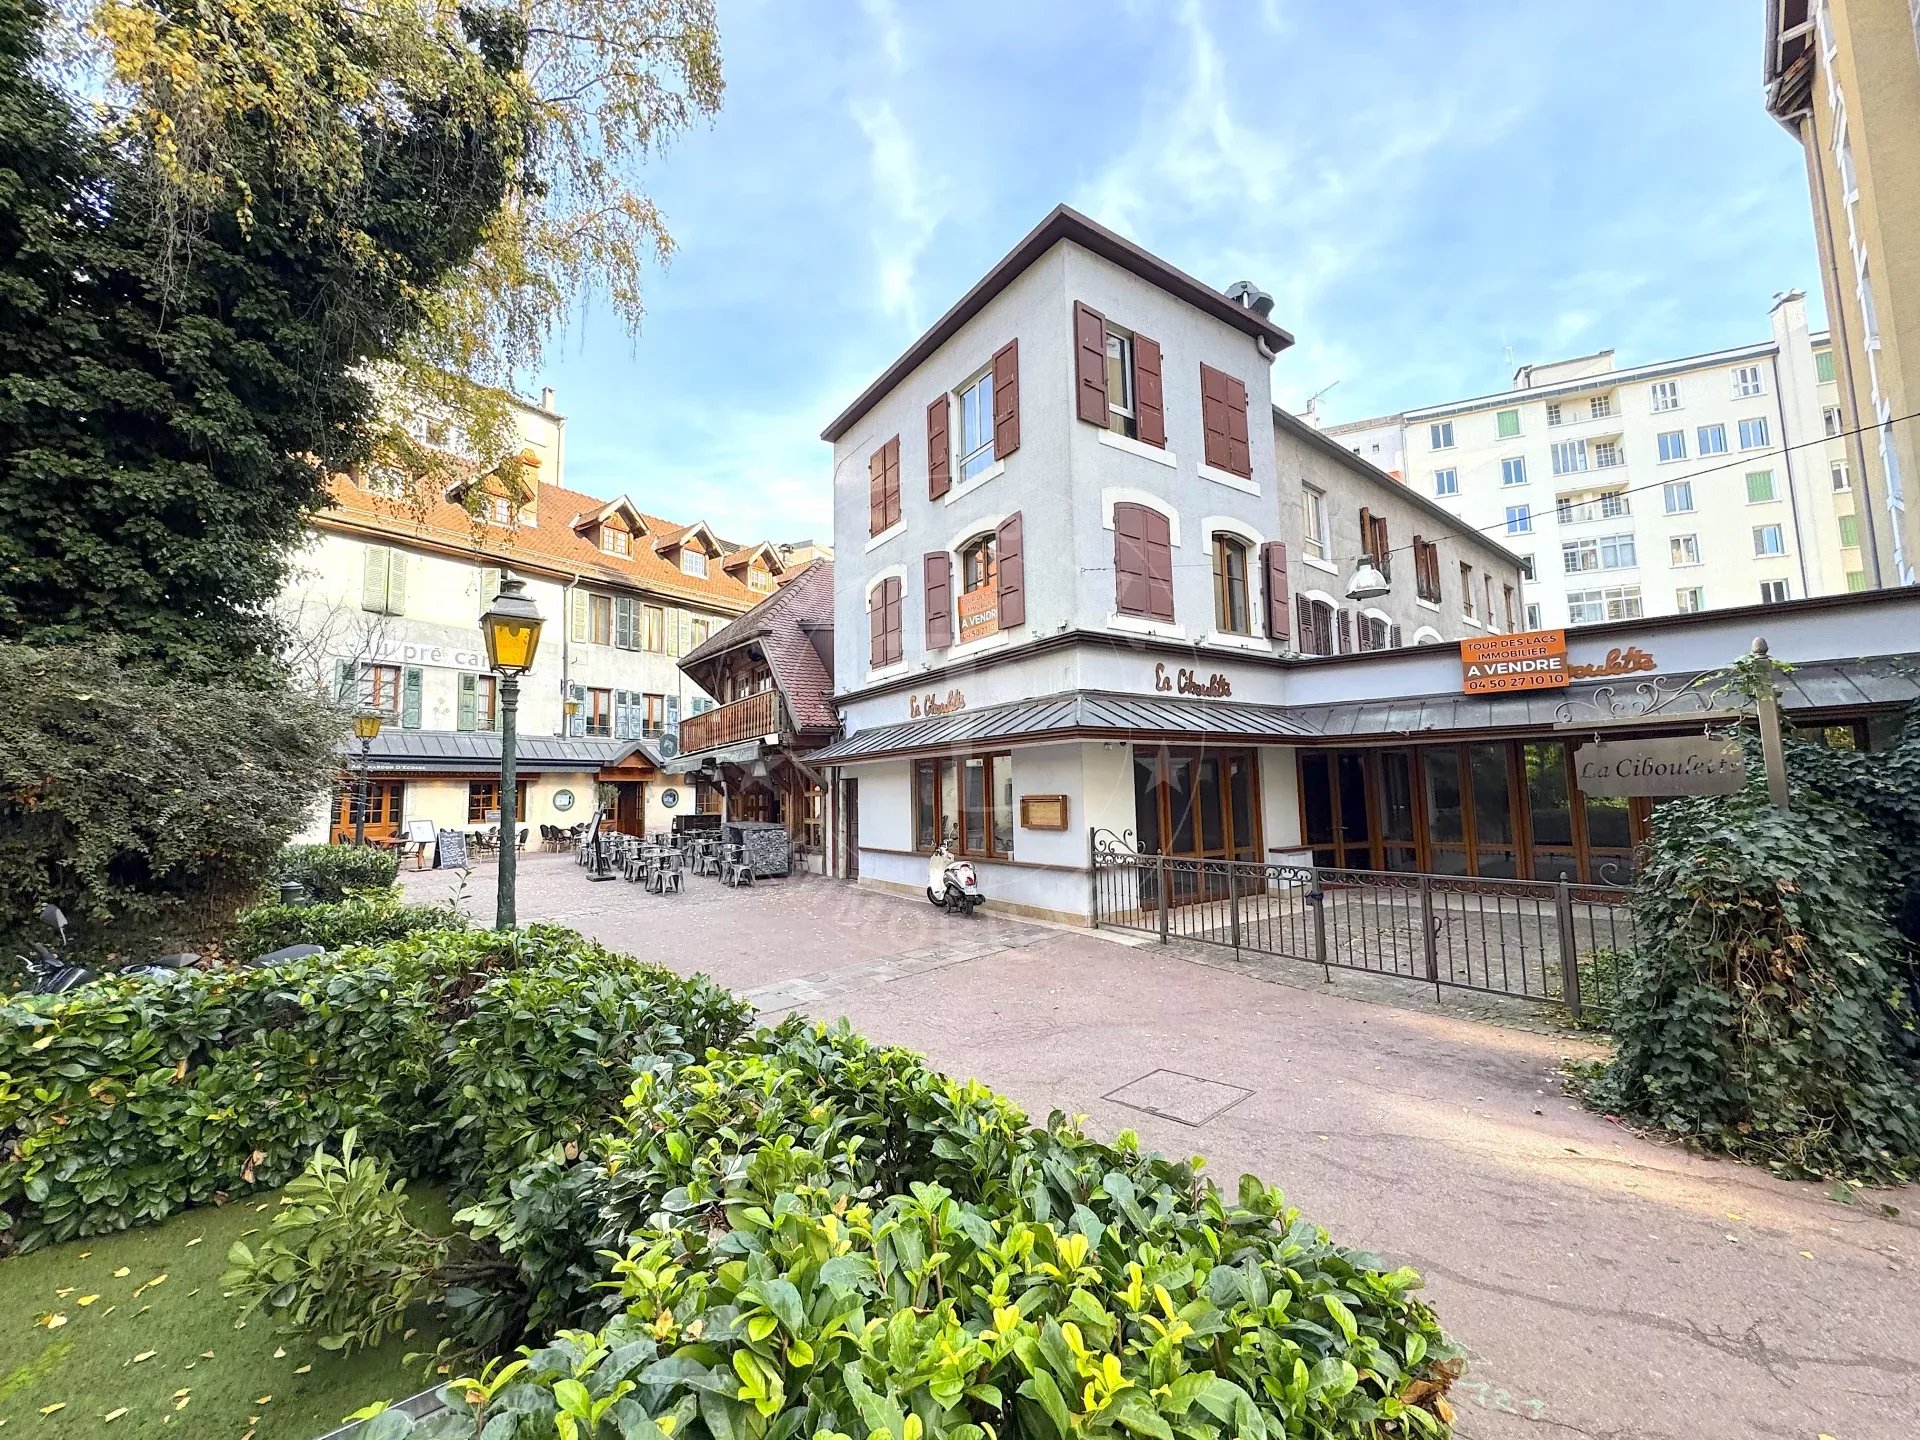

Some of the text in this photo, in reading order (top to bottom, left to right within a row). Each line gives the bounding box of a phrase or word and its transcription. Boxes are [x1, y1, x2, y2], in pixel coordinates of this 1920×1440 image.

[962, 608, 998, 628] A VENDR
[1467, 635, 1557, 651] TOUR DES LACS
[1477, 647, 1548, 661] IMMOBILIER
[1467, 657, 1562, 677] A VENDRE
[1469, 674, 1564, 690] 04 50 27 10 10
[1580, 754, 1742, 779] La Ciboulette
